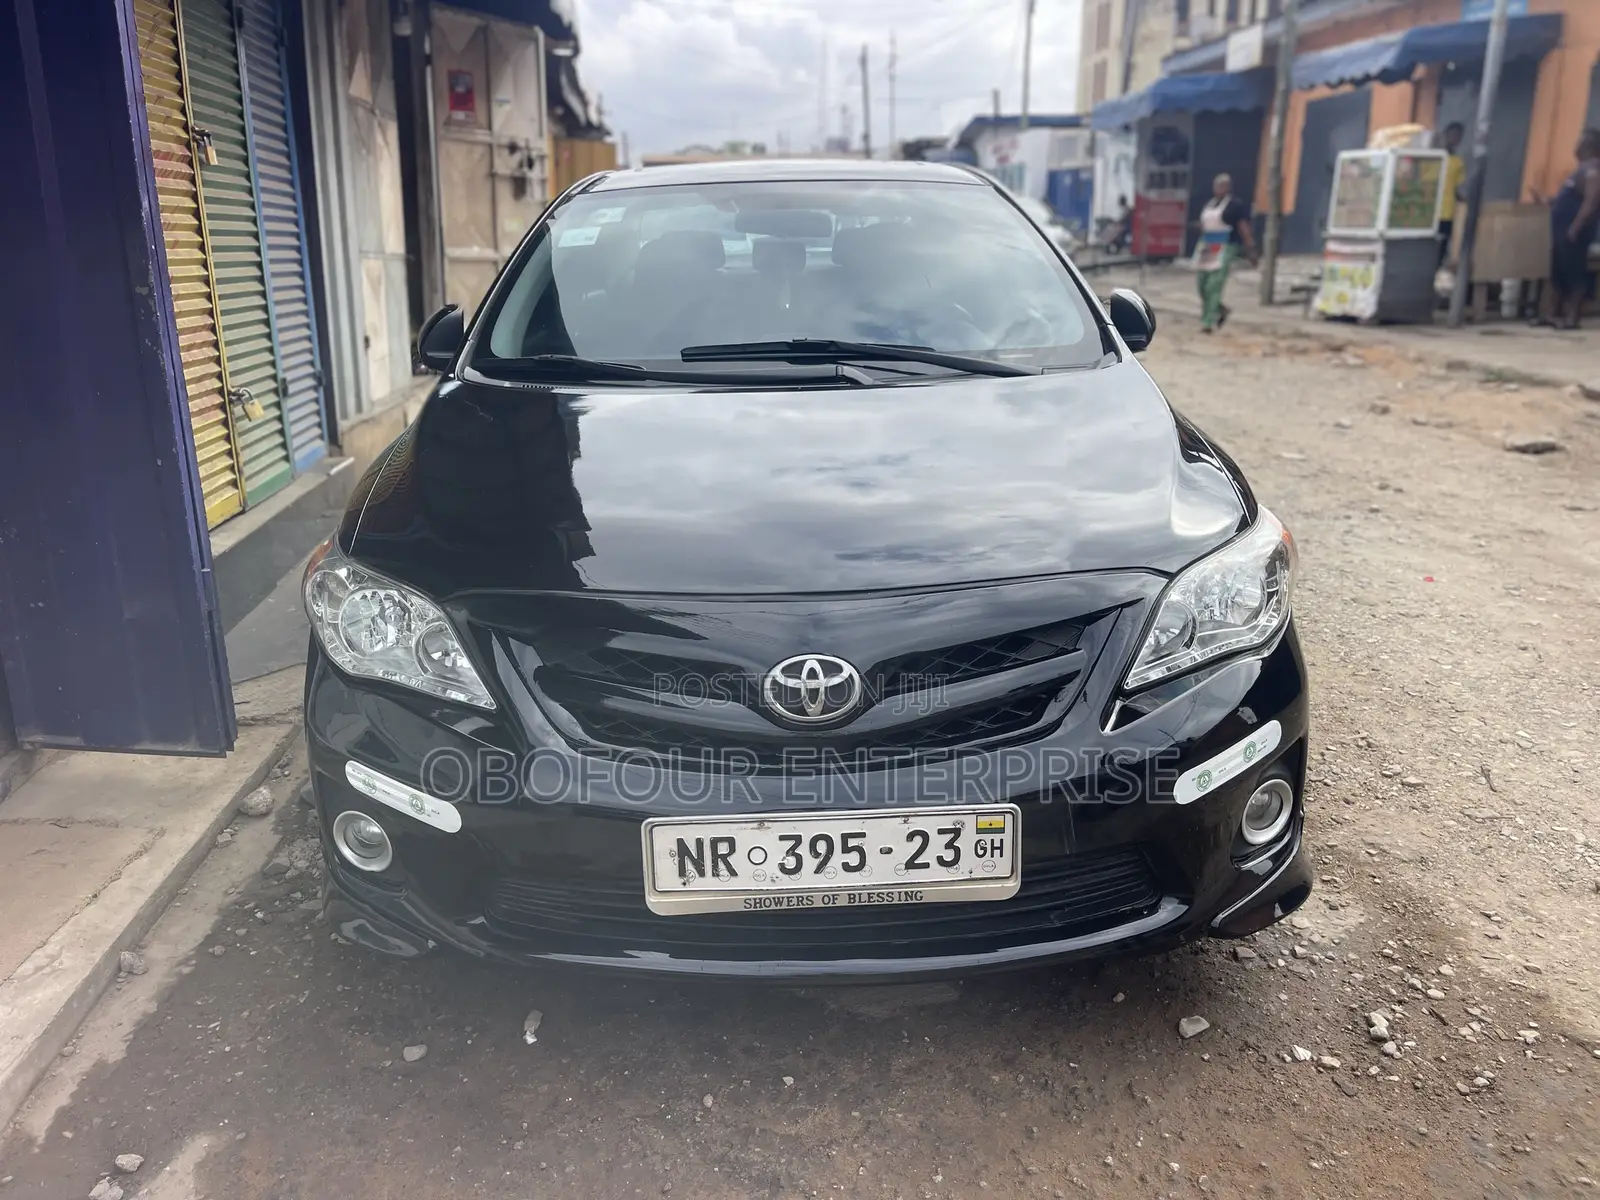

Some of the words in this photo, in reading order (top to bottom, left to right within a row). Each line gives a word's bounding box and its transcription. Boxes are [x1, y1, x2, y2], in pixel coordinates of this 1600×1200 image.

[676, 836, 739, 878] NR
[777, 833, 868, 876] 395
[904, 828, 963, 870] 23
[974, 838, 1004, 859] GH
[743, 895, 814, 910] SHOWERS
[821, 894, 840, 906] OF
[847, 890, 924, 904] BLESSING
